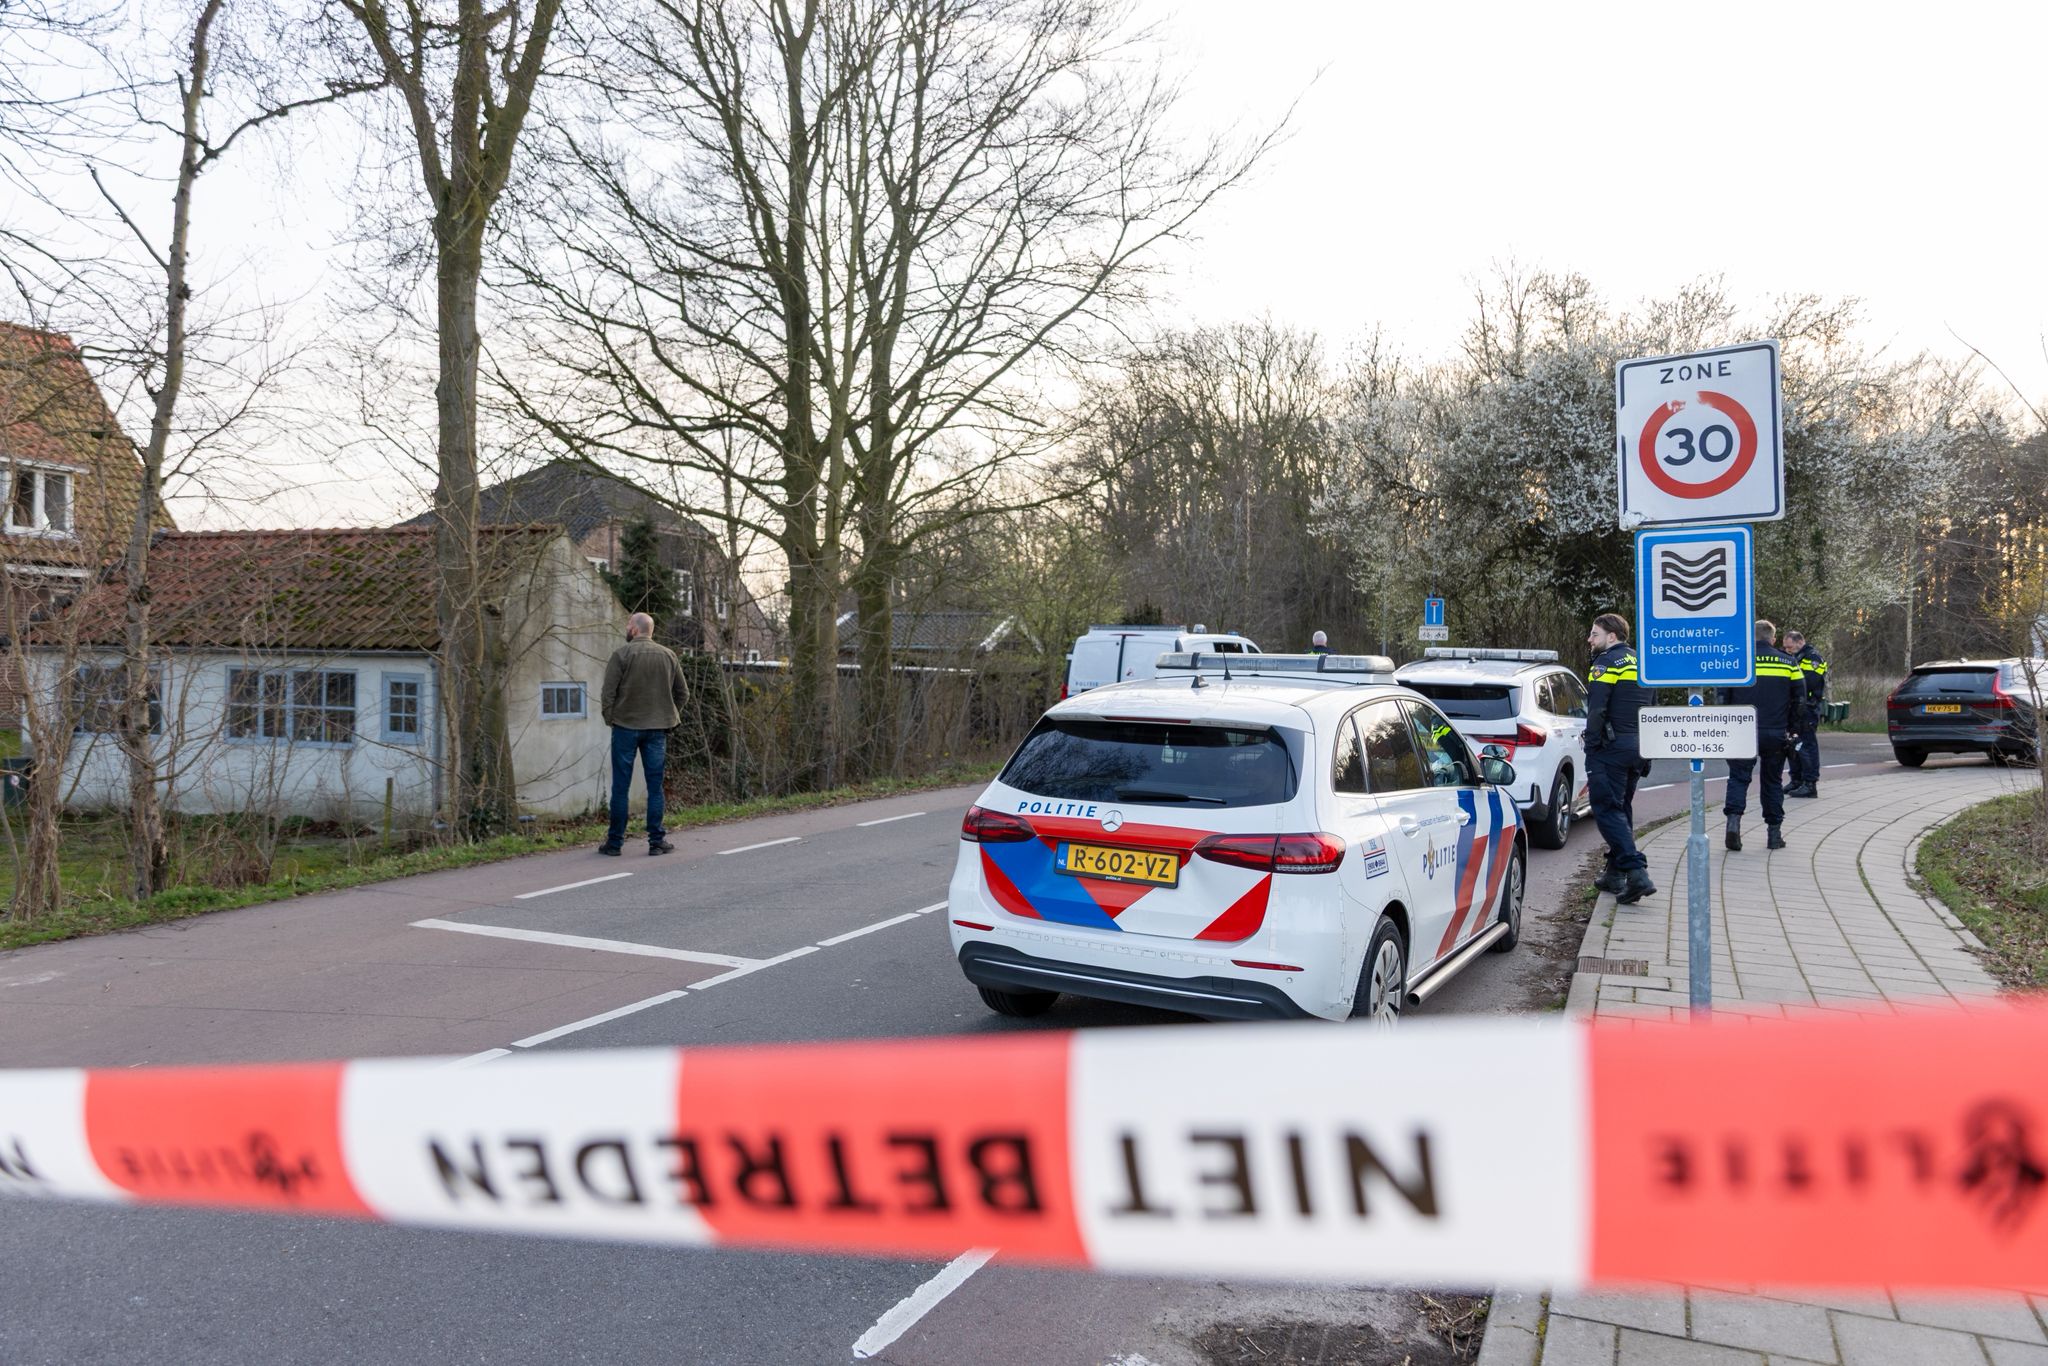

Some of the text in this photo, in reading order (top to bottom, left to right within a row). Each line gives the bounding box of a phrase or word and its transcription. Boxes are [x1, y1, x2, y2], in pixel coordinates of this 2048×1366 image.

[1660, 360, 1731, 384] ZONE
[1663, 424, 1733, 466] 30
[1650, 627, 1725, 639] Grondwater-
[1651, 643, 1740, 656] beschermings-
[1700, 658, 1739, 672] gebied
[1641, 714, 1754, 724] Bodemverontreinigingen
[1663, 729, 1730, 738] a.u.b. melden:
[1670, 744, 1725, 753] 0800-1636
[1017, 801, 1098, 818] POLITIE
[1057, 848, 1171, 878] NL R-602-VZ
[427, 1132, 1046, 1214] BETREDEN
[1109, 1127, 1440, 1219] NIET
